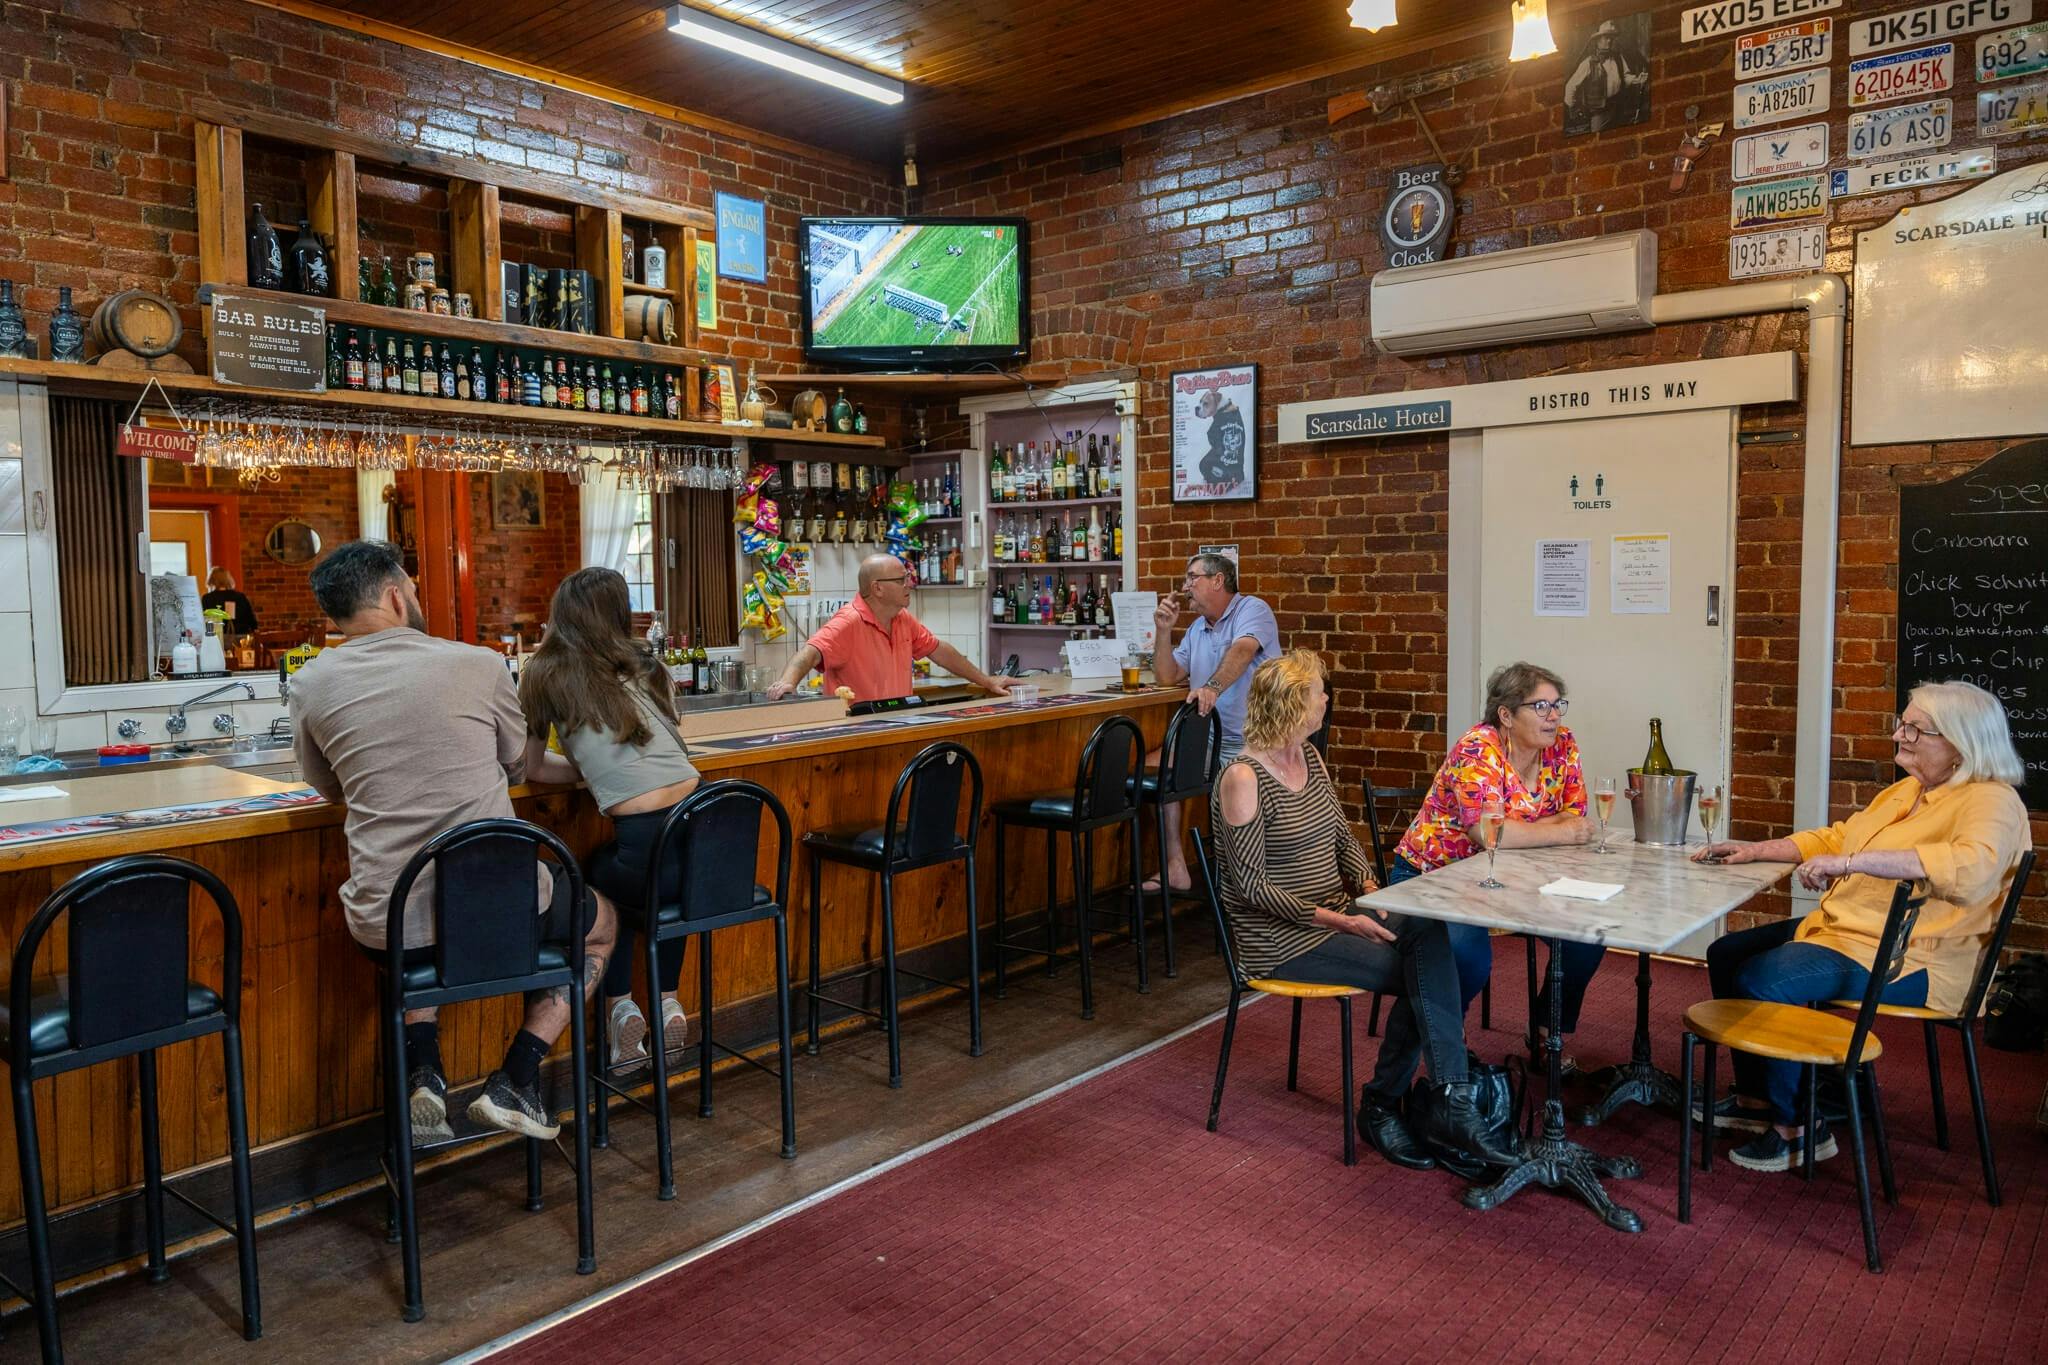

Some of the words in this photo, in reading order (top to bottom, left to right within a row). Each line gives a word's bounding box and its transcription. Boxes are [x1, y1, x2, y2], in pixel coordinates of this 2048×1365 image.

[1693, 0, 1763, 36] KX05
[1946, 0, 2010, 31] GFG
[1767, 28, 1800, 41] UTAH
[1790, 34, 1825, 62] 5RJ
[1982, 38, 2027, 70] 692
[1757, 78, 1807, 95] MONTANA
[1854, 58, 1944, 96] 62D645K
[1872, 105, 1930, 122] KANSAS
[1982, 97, 2019, 122] JGZ
[1854, 123, 1892, 151] 616
[1397, 170, 1440, 189] Beer
[1755, 164, 1775, 175] DERBY
[1776, 160, 1802, 172] FESTIVAL
[1870, 166, 1931, 187] FECK
[1938, 161, 1960, 177] IT
[1745, 185, 1821, 218] AWW8556
[722, 209, 761, 236] ENGLISH
[1894, 214, 2015, 244] SCARSDALE
[1391, 246, 1435, 268] Clock
[1734, 241, 1767, 271] 1935
[217, 309, 257, 327] BAR
[263, 315, 321, 335] RULES
[249, 334, 291, 346] BARTENDER
[249, 341, 278, 351] ALWAYS
[279, 345, 301, 353] RIGHT
[259, 355, 299, 367] BARTENDER
[1529, 391, 1590, 411] BISTRO
[1608, 385, 1651, 403] THIS
[1663, 380, 1697, 398] WAY
[1311, 412, 1388, 435] Scarsdale
[1395, 405, 1446, 428] Hotel
[124, 431, 194, 453] WELCOME
[141, 449, 154, 457] ANY
[1573, 500, 1612, 510] TOILETS
[1911, 528, 2029, 553] Carbonara
[1905, 570, 1963, 596] Chick
[1951, 596, 2032, 627] burger
[1912, 642, 1966, 667] Fish
